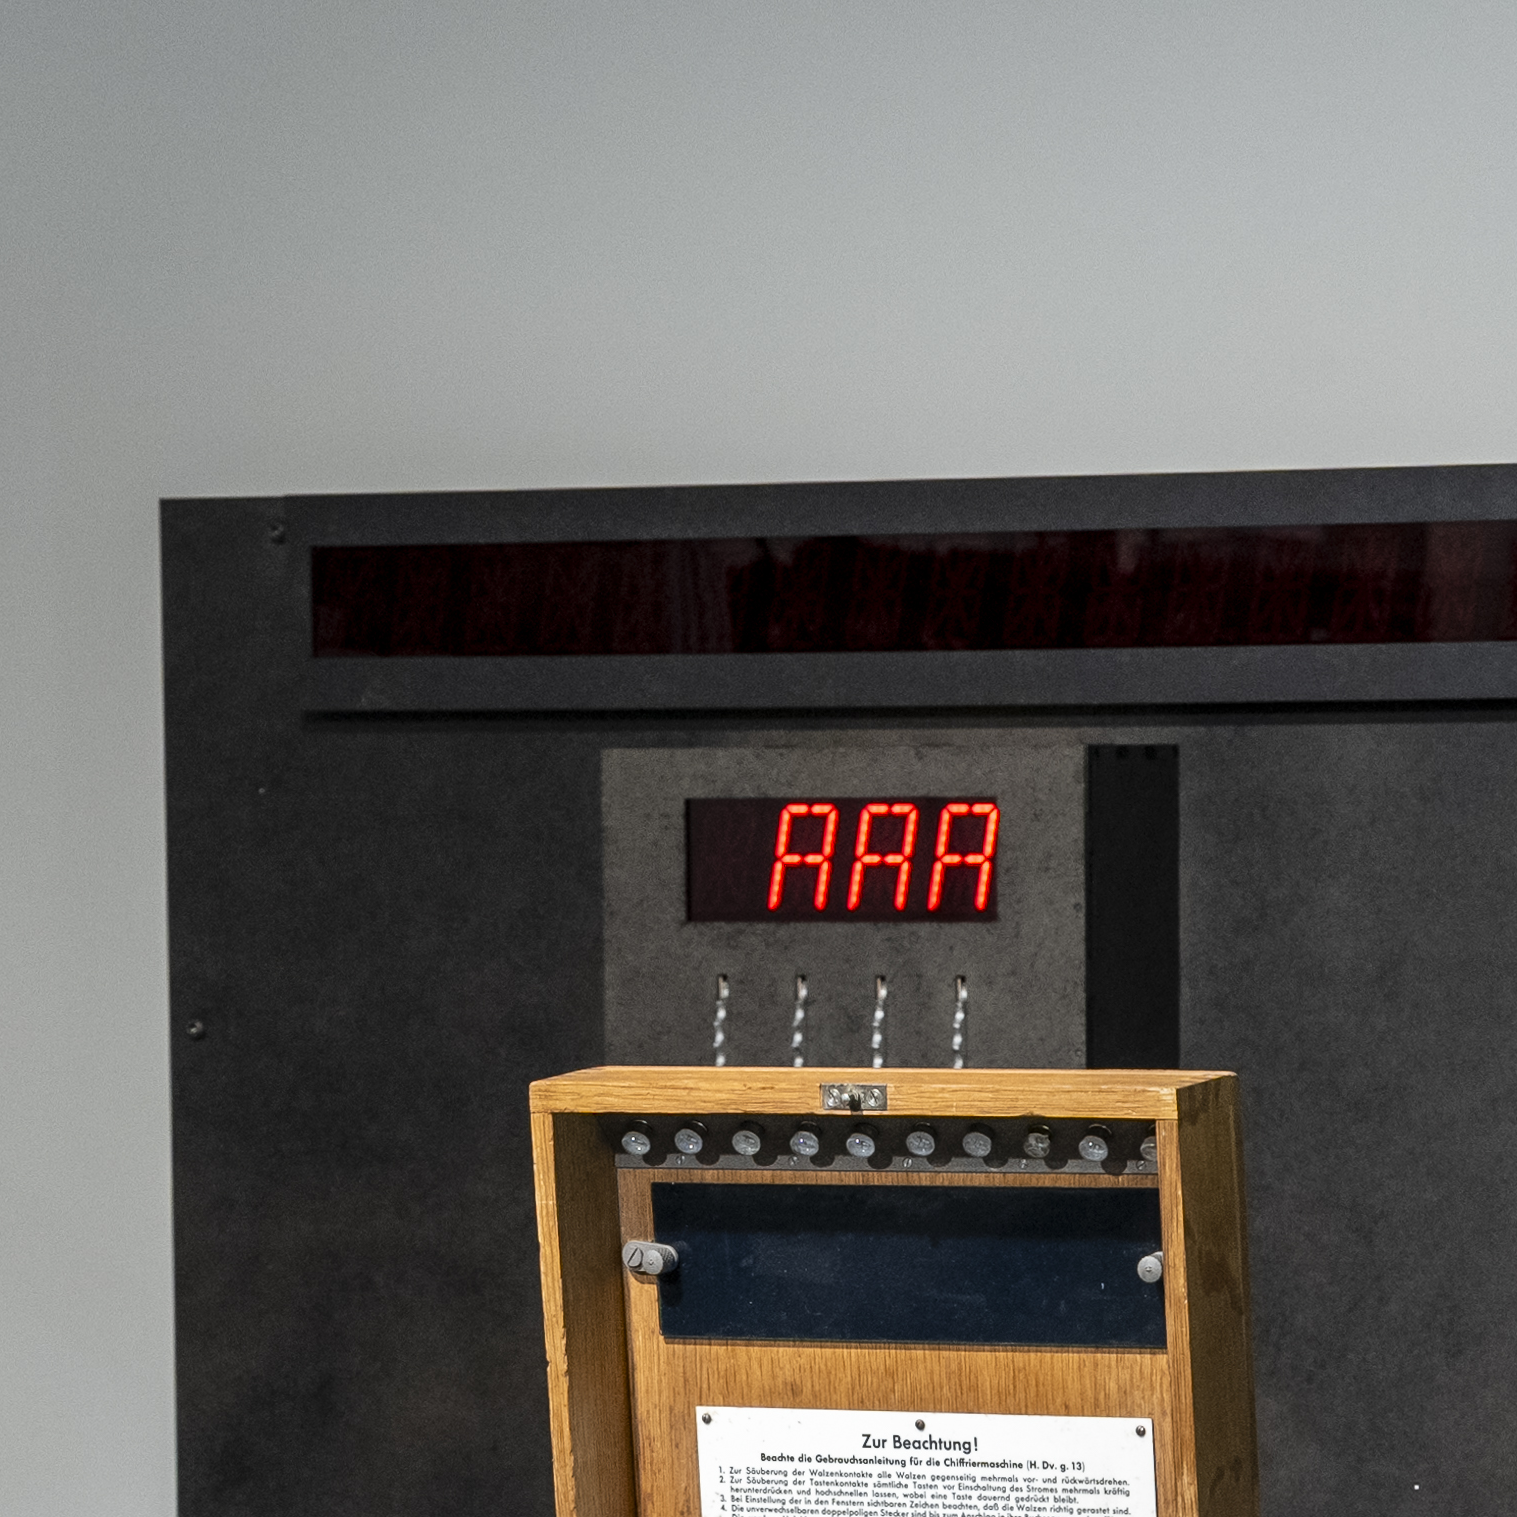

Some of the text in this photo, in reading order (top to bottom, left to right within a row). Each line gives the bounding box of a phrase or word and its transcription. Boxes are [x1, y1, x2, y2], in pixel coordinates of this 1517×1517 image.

[766, 802, 1000, 911] AAA
[861, 1433, 978, 1455] Zur Beachtung!
[760, 1452, 1085, 1473] Beachte die Gebrauchsanleitung für die Chiffriermaschine (H. Dv. g. 13)
[718, 1466, 725, 1474] 1.
[729, 1466, 742, 1475] Zur
[746, 1466, 788, 1478] Säuberung
[791, 1468, 805, 1476] der
[808, 1468, 873, 1479] Walzenkontakte
[877, 1471, 892, 1479] alle
[895, 1471, 927, 1480] Walzen
[930, 1473, 977, 1483] gegenseitig
[980, 1474, 1019, 1483] mehrmals
[1042, 1476, 1058, 1484] und
[1061, 1476, 1130, 1486] rückwärtsdrehen.
